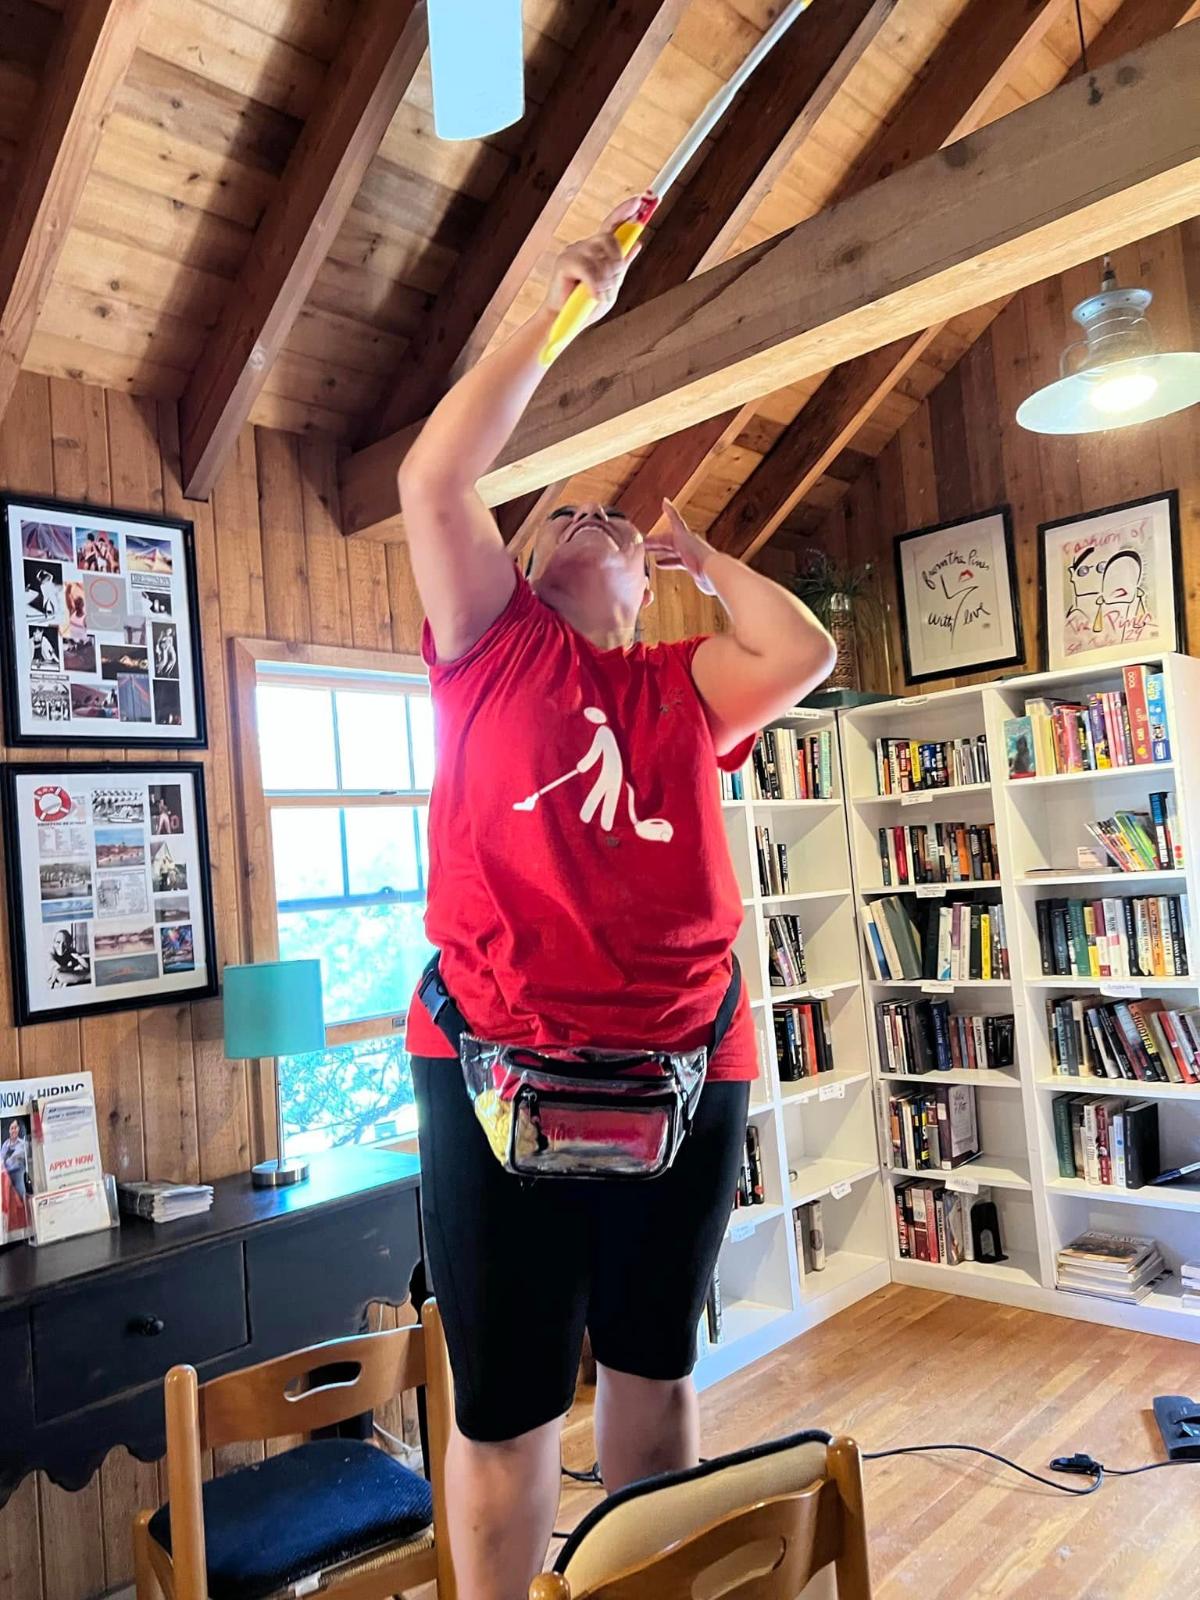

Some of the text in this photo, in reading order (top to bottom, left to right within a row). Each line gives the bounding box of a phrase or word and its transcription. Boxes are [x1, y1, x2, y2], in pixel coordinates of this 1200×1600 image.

[1133, 1011, 1154, 1049] SHOOTER
[0, 1091, 25, 1108] NOW
[49, 1157, 73, 1172] APPLY
[75, 1153, 94, 1166] NOW
